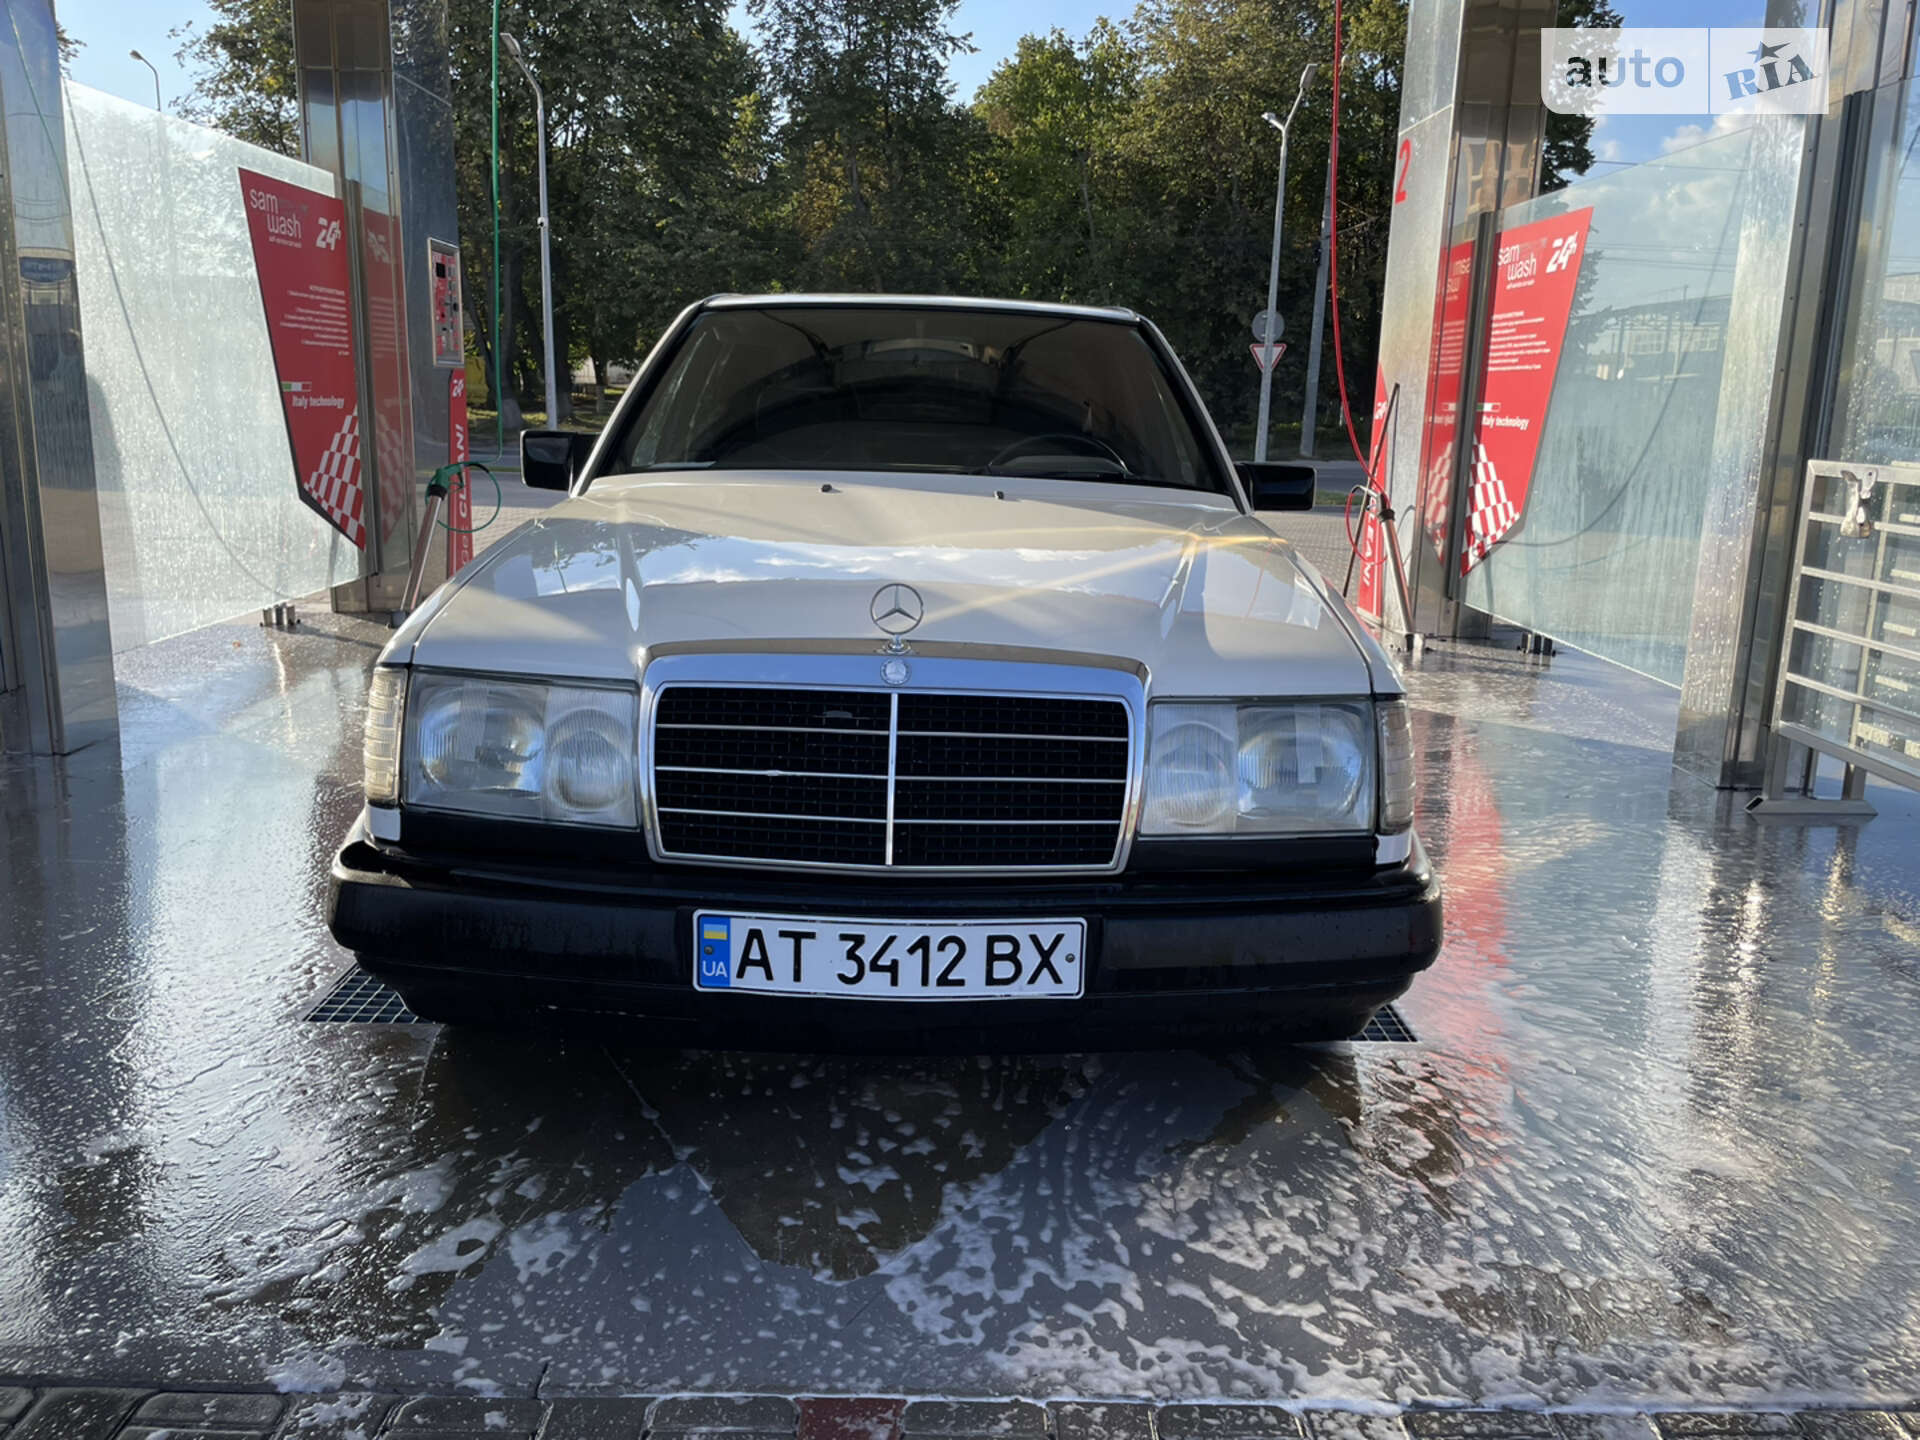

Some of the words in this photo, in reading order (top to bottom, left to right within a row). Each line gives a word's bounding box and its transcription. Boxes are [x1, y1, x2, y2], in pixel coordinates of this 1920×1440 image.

[1395, 138, 1411, 204] 2
[249, 188, 279, 215] sam
[267, 213, 302, 239] wash
[1498, 245, 1520, 266] sam
[1507, 252, 1536, 281] wash
[292, 395, 307, 409] Italy
[309, 395, 344, 408] technology
[1496, 416, 1529, 431] technology
[702, 960, 728, 978] UA
[736, 928, 816, 983] AT
[836, 933, 967, 987] 3412
[985, 933, 1065, 987] BX
